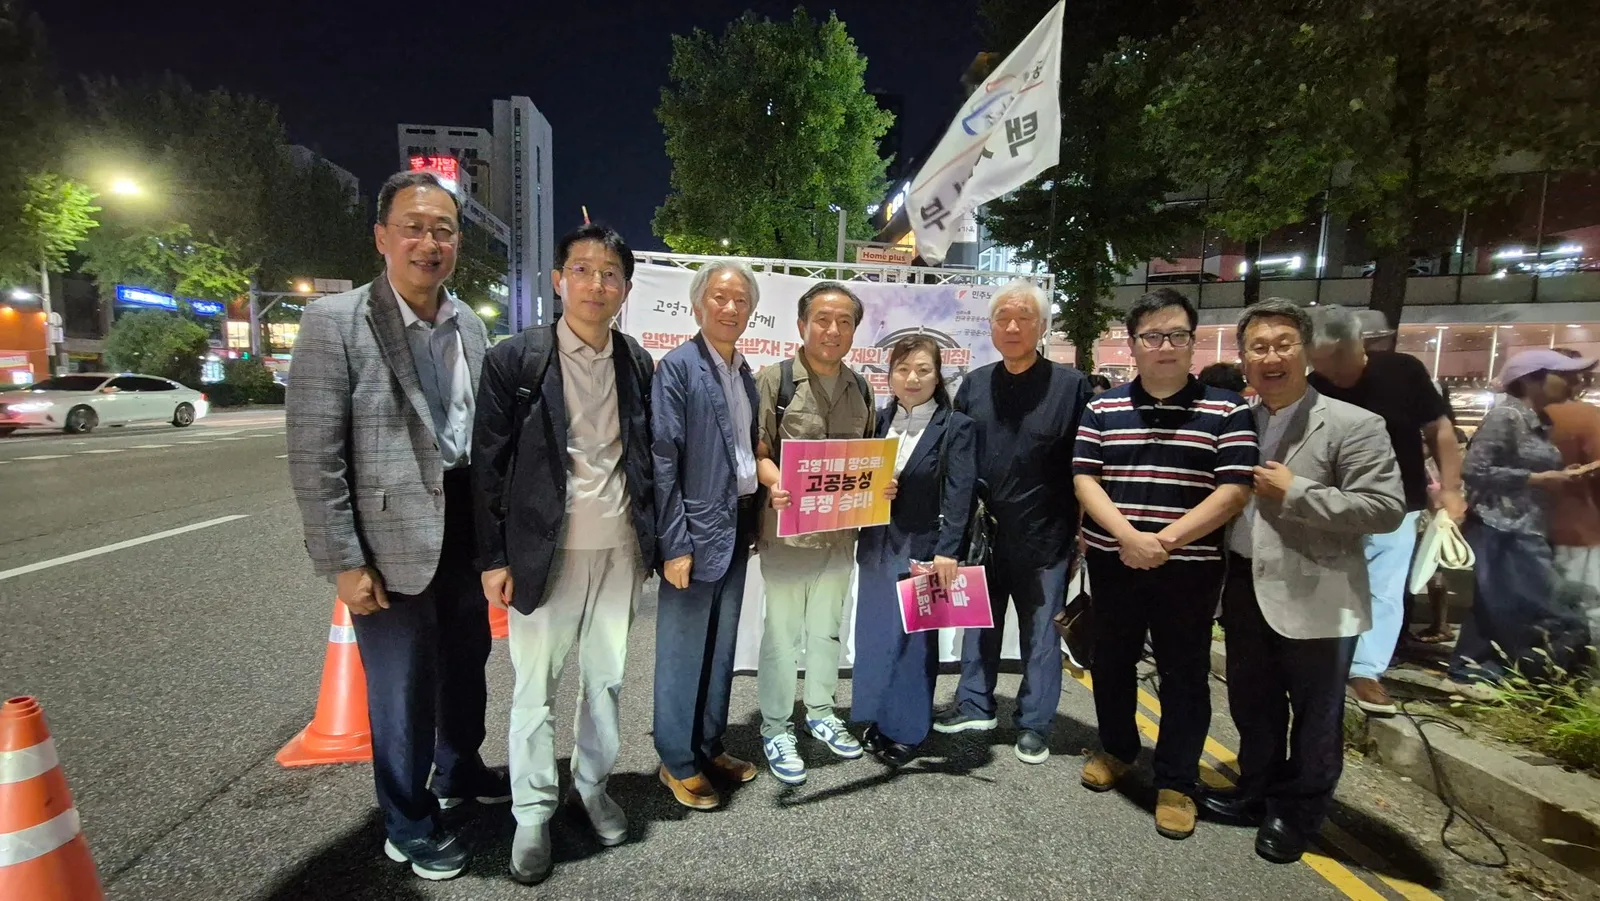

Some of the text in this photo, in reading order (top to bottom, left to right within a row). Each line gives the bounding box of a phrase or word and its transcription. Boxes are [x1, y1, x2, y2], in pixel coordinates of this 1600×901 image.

[863, 252, 905, 262] Home plus
[972, 291, 992, 299] 민주노
[653, 299, 693, 316] 고영기
[850, 347, 882, 365] 제외
[797, 456, 884, 473] 고영기를 땅으로!
[805, 471, 873, 493] 고공농성
[799, 490, 873, 515] 투쟁 승리!
